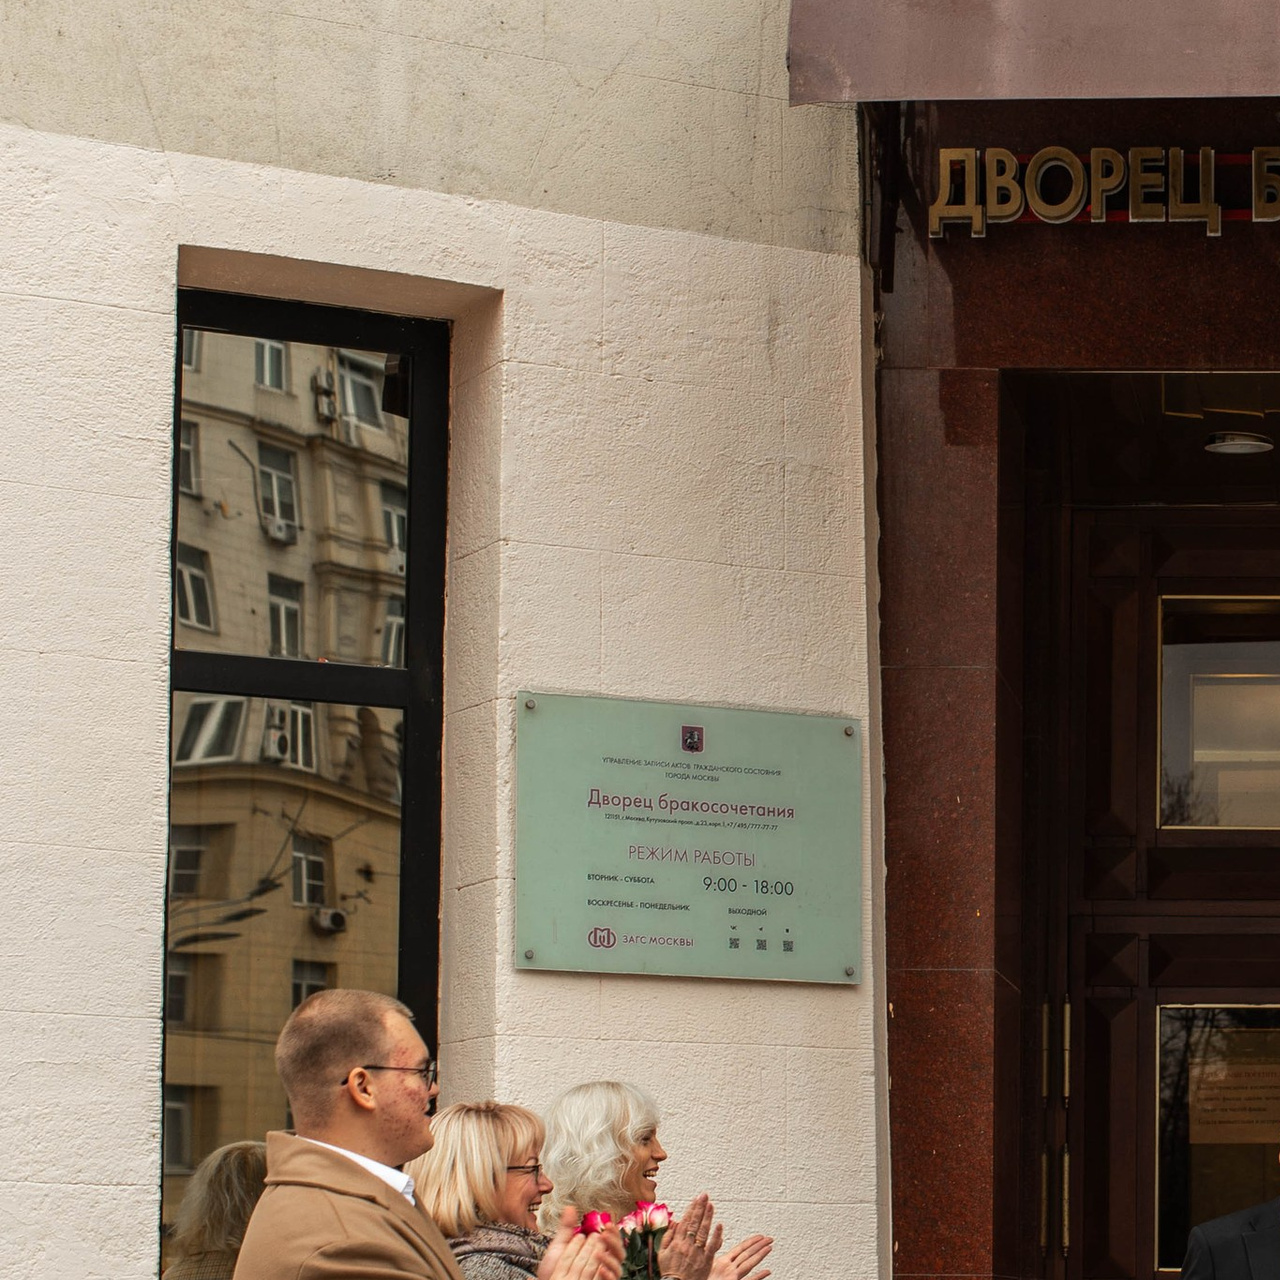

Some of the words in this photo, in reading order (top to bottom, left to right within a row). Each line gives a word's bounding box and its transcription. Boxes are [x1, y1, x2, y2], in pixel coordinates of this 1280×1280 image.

[929, 145, 1221, 237] ДВОРЕЦ
[602, 756, 642, 766] УПРАВЛЕНИЕ
[643, 760, 670, 768] ЗАПИСИ
[671, 762, 691, 770] АКТОВ
[693, 763, 743, 774] ГРАЖДАНСКОГО
[744, 767, 781, 776] СОСТОЯНИЯ
[665, 772, 691, 781] ГОРОДА
[691, 773, 720, 782] МОСКВЫ
[587, 788, 654, 811] Дворец
[658, 793, 795, 819] бракосочетания
[628, 845, 688, 863] РЕЖИМ
[694, 850, 755, 867] РАБОТЫ
[587, 873, 619, 882] ВТОРНИК
[624, 876, 655, 884] СУББОТА
[703, 877, 738, 892] 9:00
[754, 880, 794, 896] 18:00
[587, 899, 634, 908] ВОСКРЕСЕНЬЕ
[640, 902, 691, 911] ПОНЕДЕЛЬНИК
[728, 907, 767, 916] ВЫХОДНОЙ
[622, 935, 647, 944] ЗАГС
[649, 937, 694, 947] МОСКВЫ
